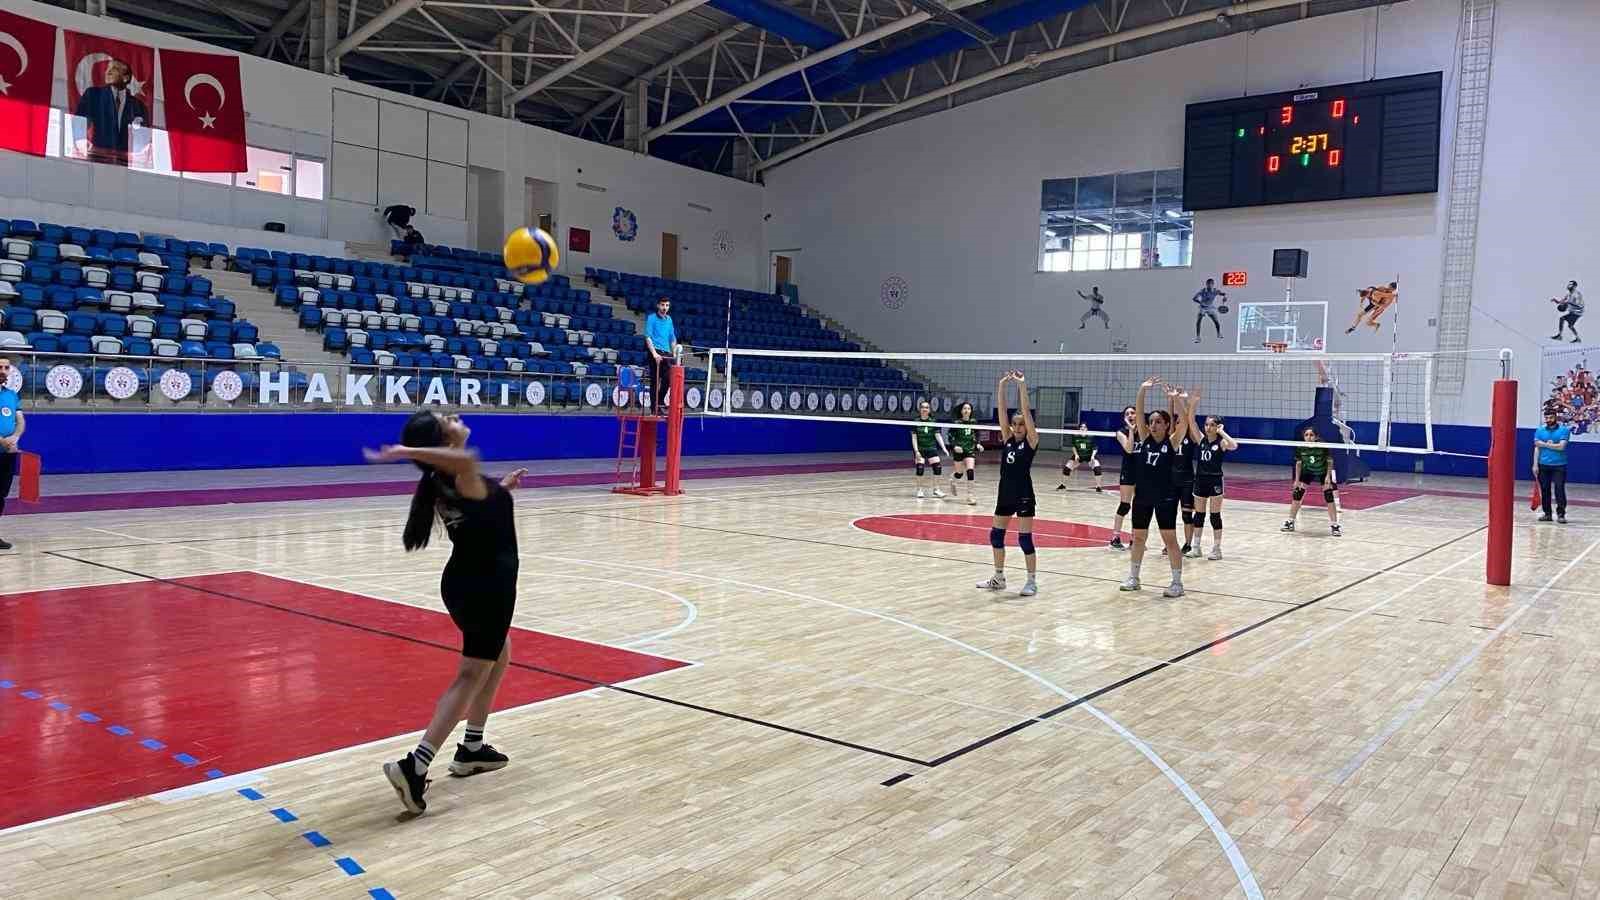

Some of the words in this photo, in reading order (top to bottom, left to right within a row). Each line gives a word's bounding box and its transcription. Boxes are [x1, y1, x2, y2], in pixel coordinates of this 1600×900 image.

[1281, 106, 1293, 124] 3
[1332, 99, 1345, 118] 0
[1291, 133, 1328, 154] 2:37
[1269, 156, 1279, 171] 0
[1302, 153, 1309, 166] 1
[1329, 149, 1340, 166] 0
[1006, 451, 1016, 464] 8
[1145, 452, 1160, 467] 17
[1200, 450, 1212, 462] 10
[1309, 455, 1315, 464] 3
